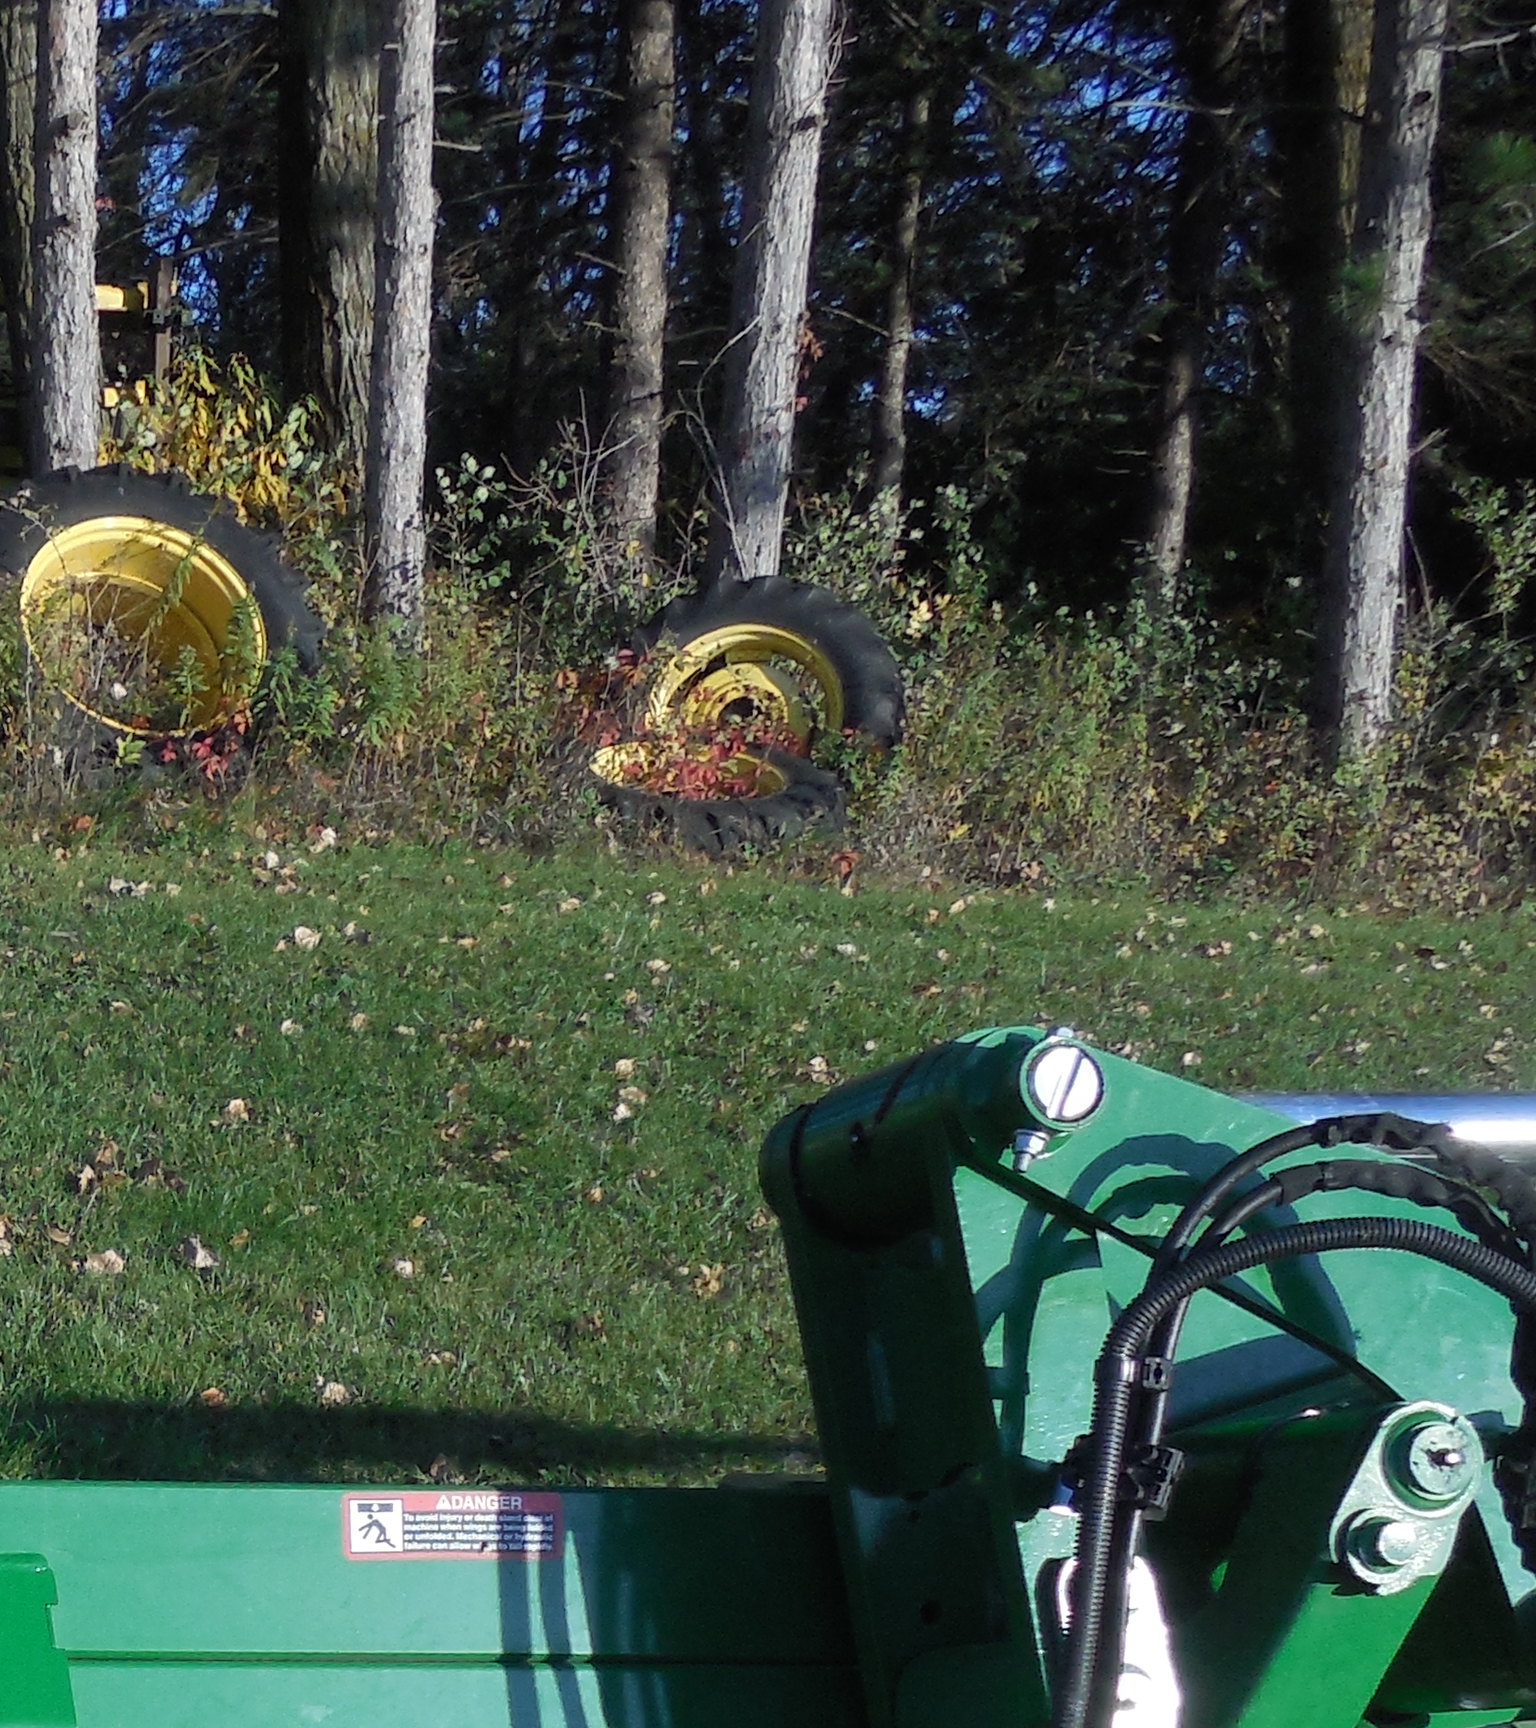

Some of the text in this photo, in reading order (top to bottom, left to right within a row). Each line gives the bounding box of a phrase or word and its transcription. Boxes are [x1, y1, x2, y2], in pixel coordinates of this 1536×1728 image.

[452, 1495, 522, 1510] DANGER
[403, 1513, 414, 1521] To
[439, 1513, 463, 1523] injury
[474, 1513, 497, 1521] death
